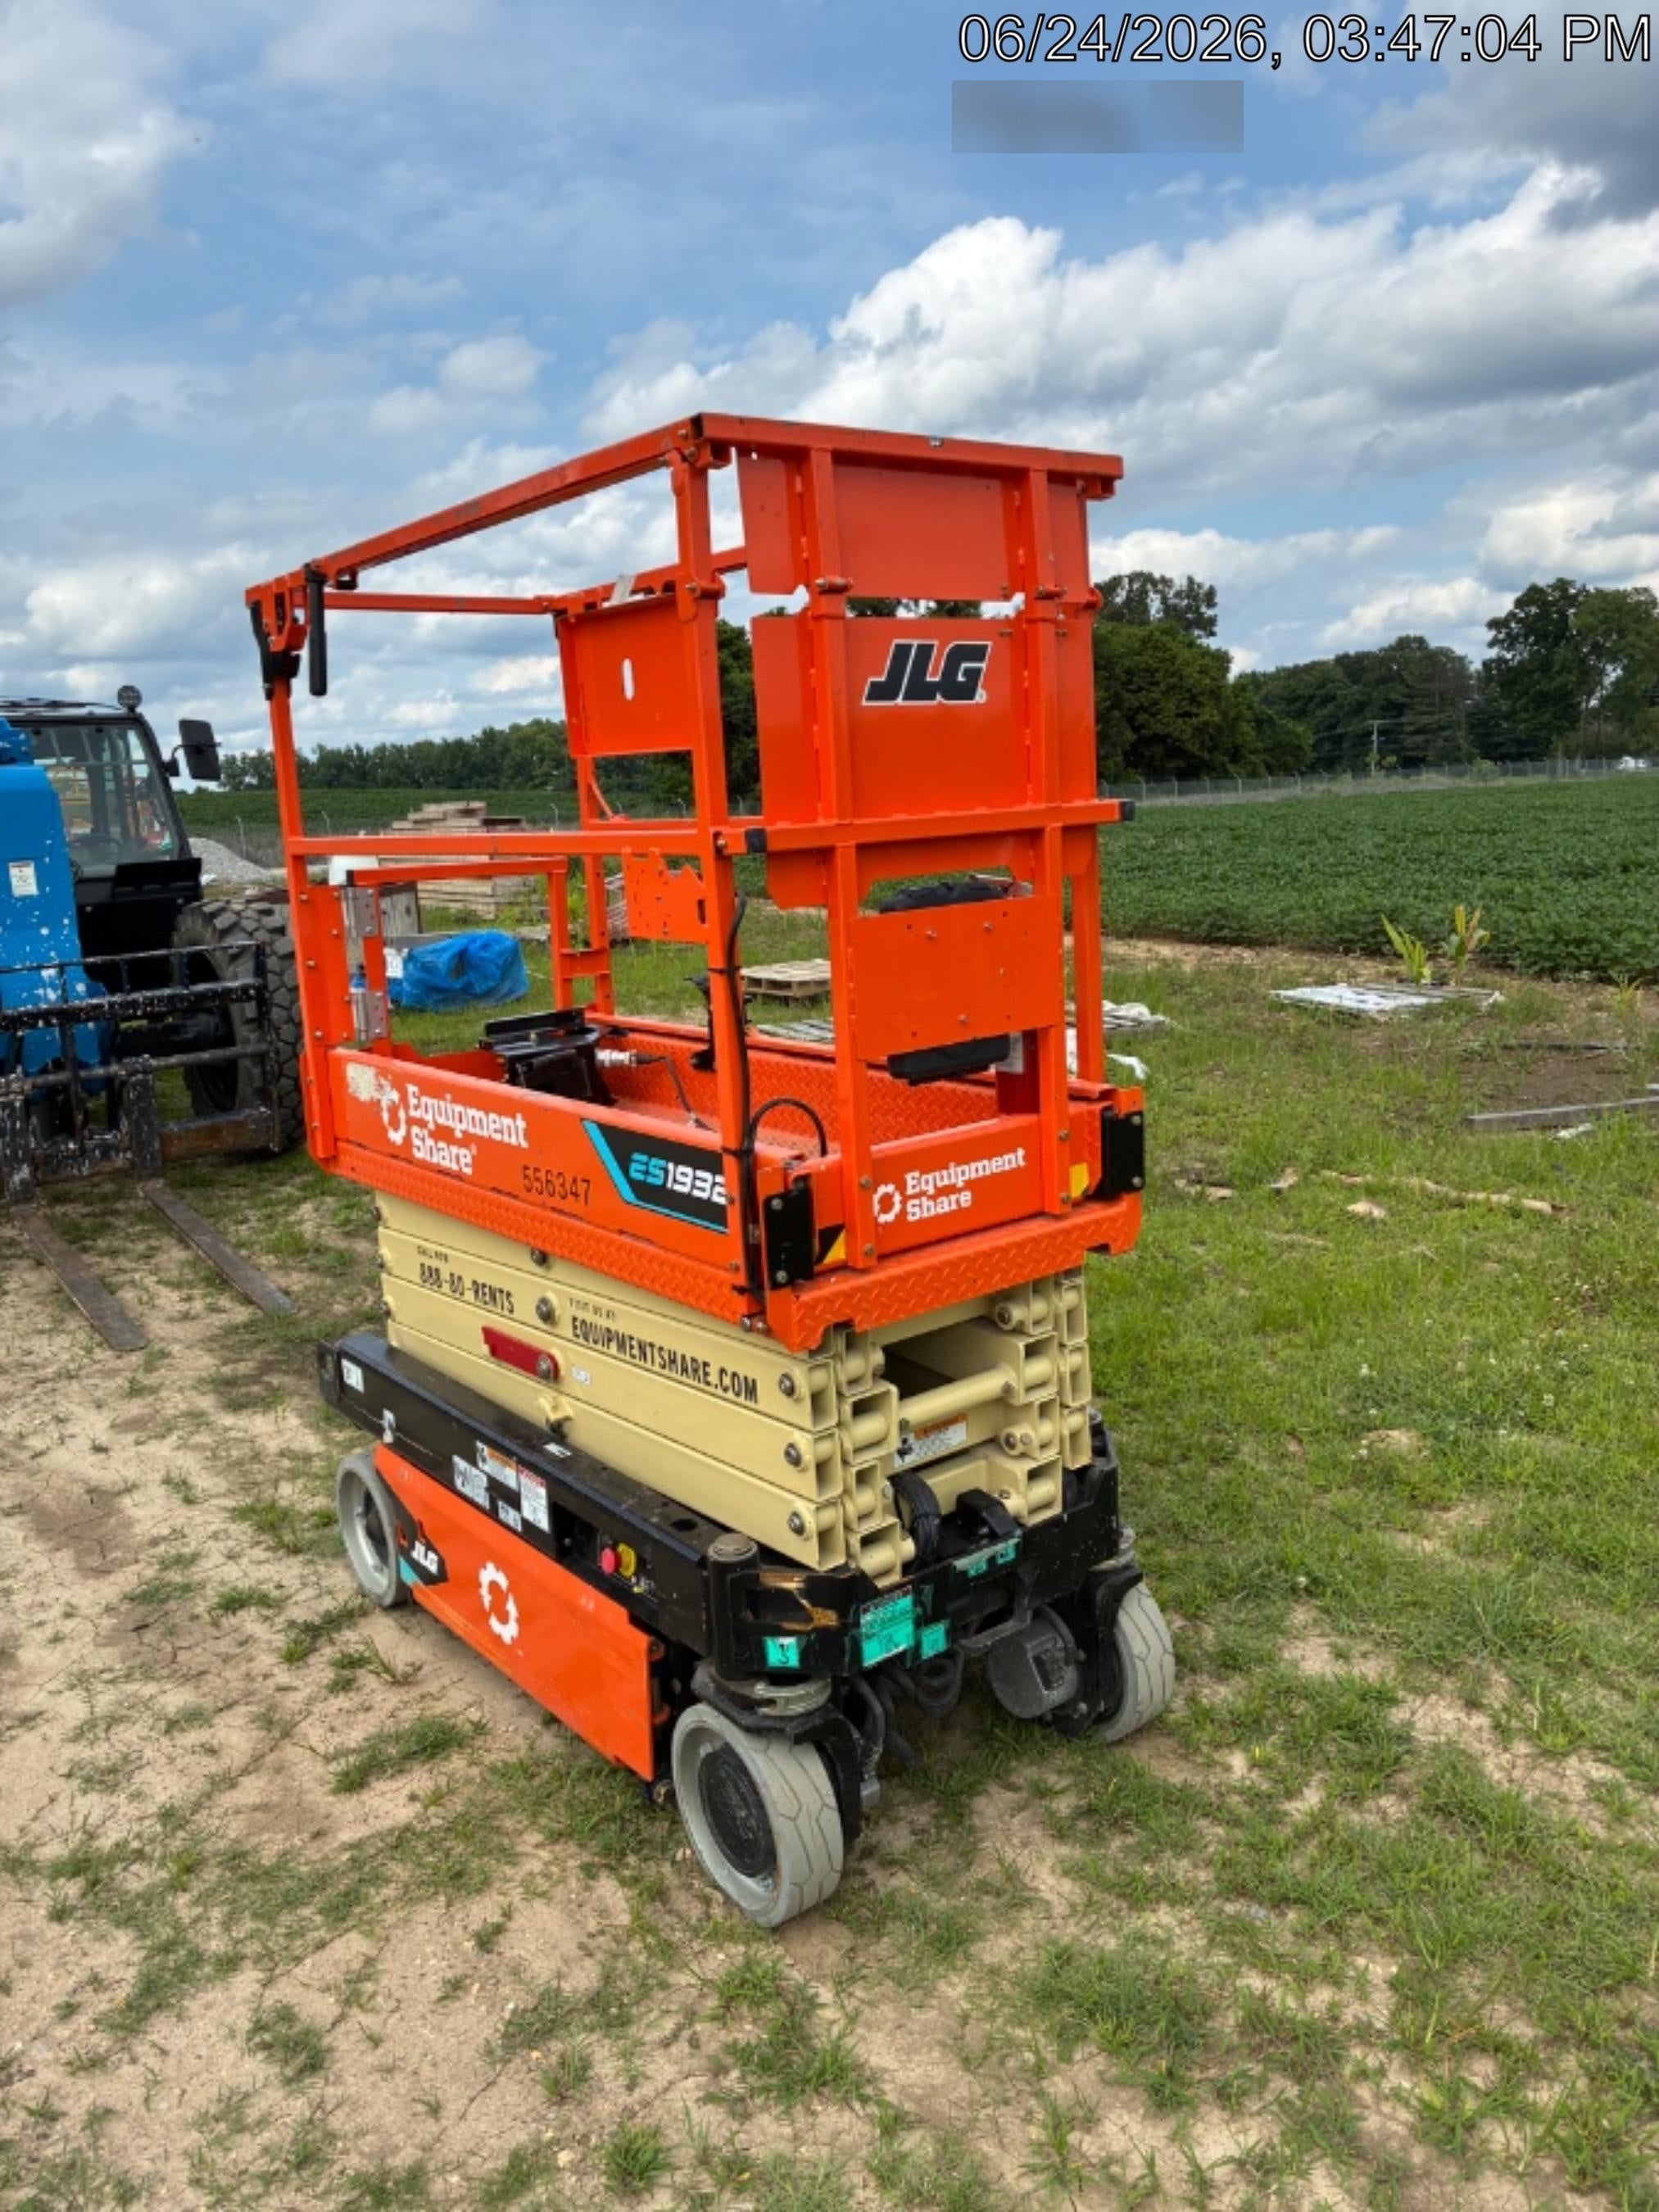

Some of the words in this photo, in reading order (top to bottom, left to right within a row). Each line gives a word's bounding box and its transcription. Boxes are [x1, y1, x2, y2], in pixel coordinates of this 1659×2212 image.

[862, 639, 991, 705] JLG
[406, 1083, 528, 1149] Equipment
[522, 1164, 590, 1206] 556347
[628, 1152, 728, 1206] ES1932
[904, 1147, 1025, 1194] Equipment
[906, 1190, 972, 1222] Share
[419, 1262, 514, 1314] 888-80-RENTS
[572, 1315, 758, 1403] EQUIPMENTSHARE.COM
[410, 1540, 439, 1575] JLG
